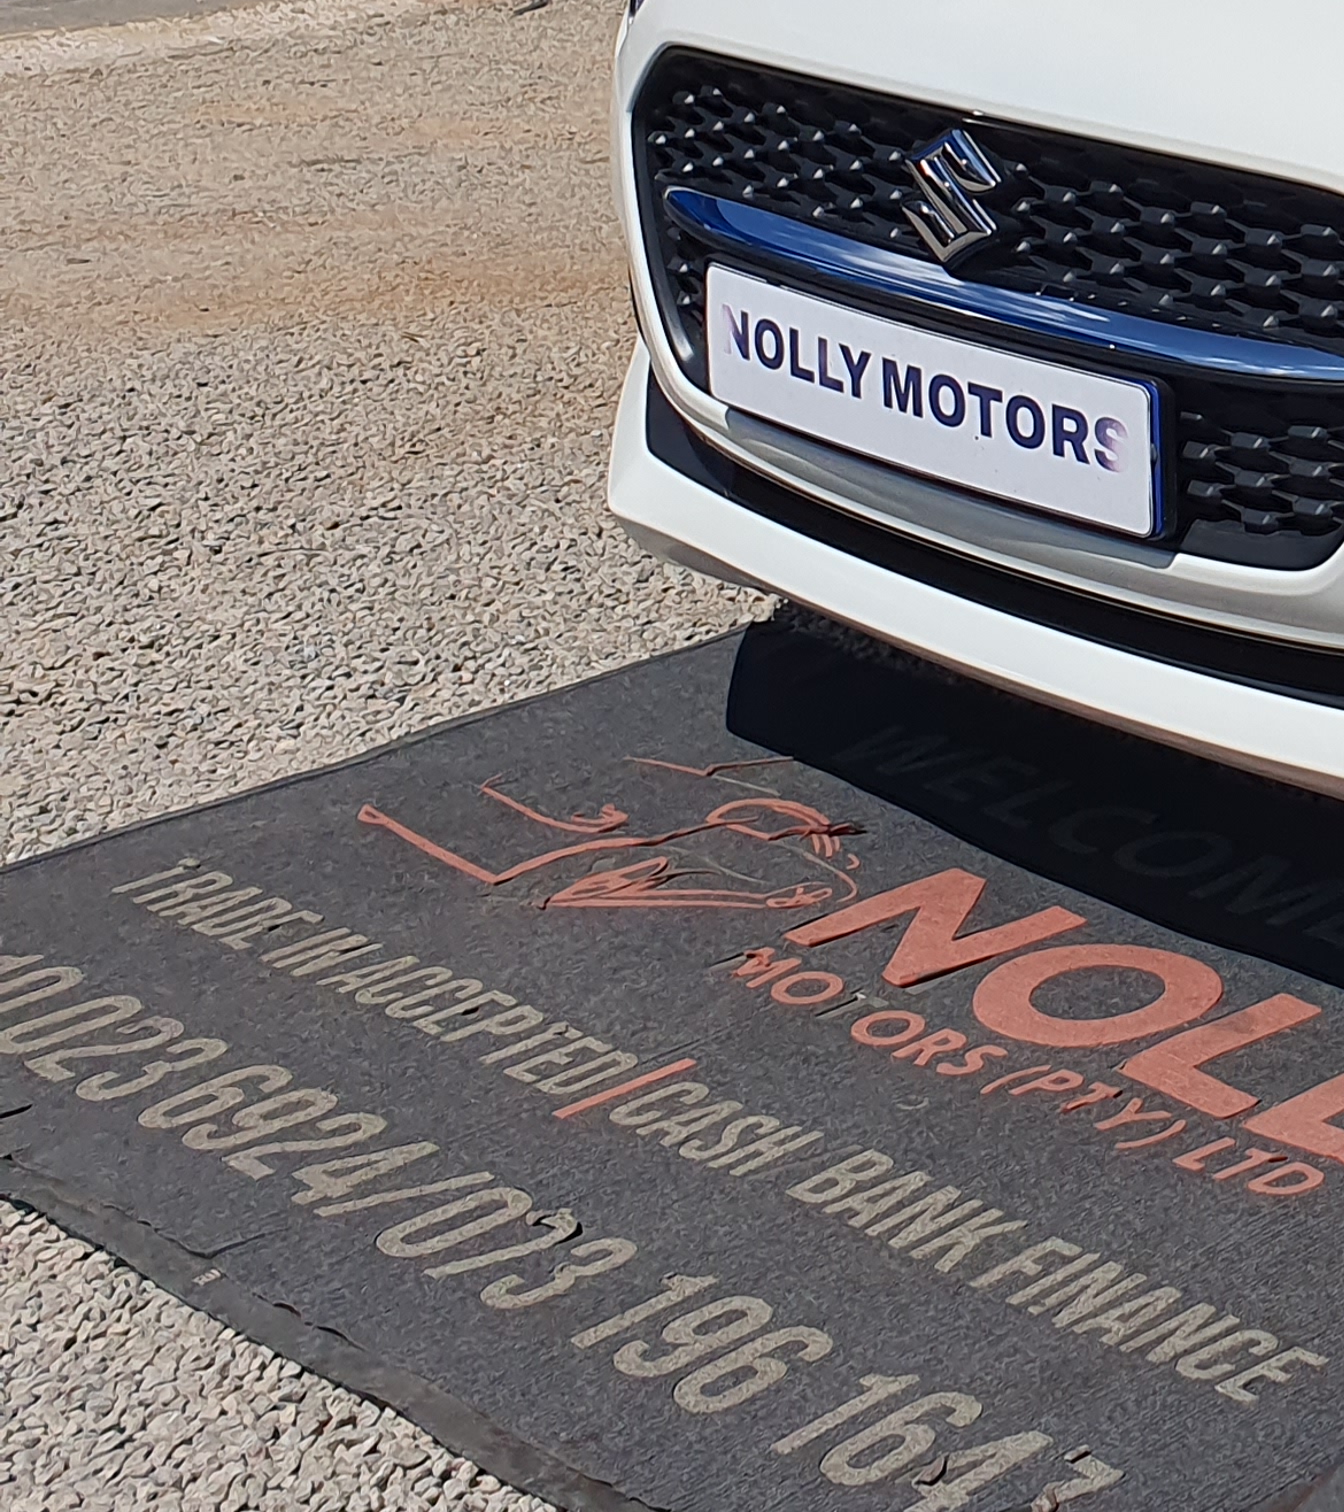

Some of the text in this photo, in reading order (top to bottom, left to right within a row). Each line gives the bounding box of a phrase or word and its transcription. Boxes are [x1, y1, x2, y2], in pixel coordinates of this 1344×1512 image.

[720, 301, 1128, 474] NOLLY MOTORS
[113, 858, 325, 951] TRADE
[260, 927, 384, 977] IN
[786, 1148, 1028, 1273] BANK
[969, 1236, 1331, 1403] FINANCE
[979, 1064, 1187, 1150] (PTY)
[1172, 1137, 1325, 1195] LTD
[570, 1271, 834, 1414] 196
